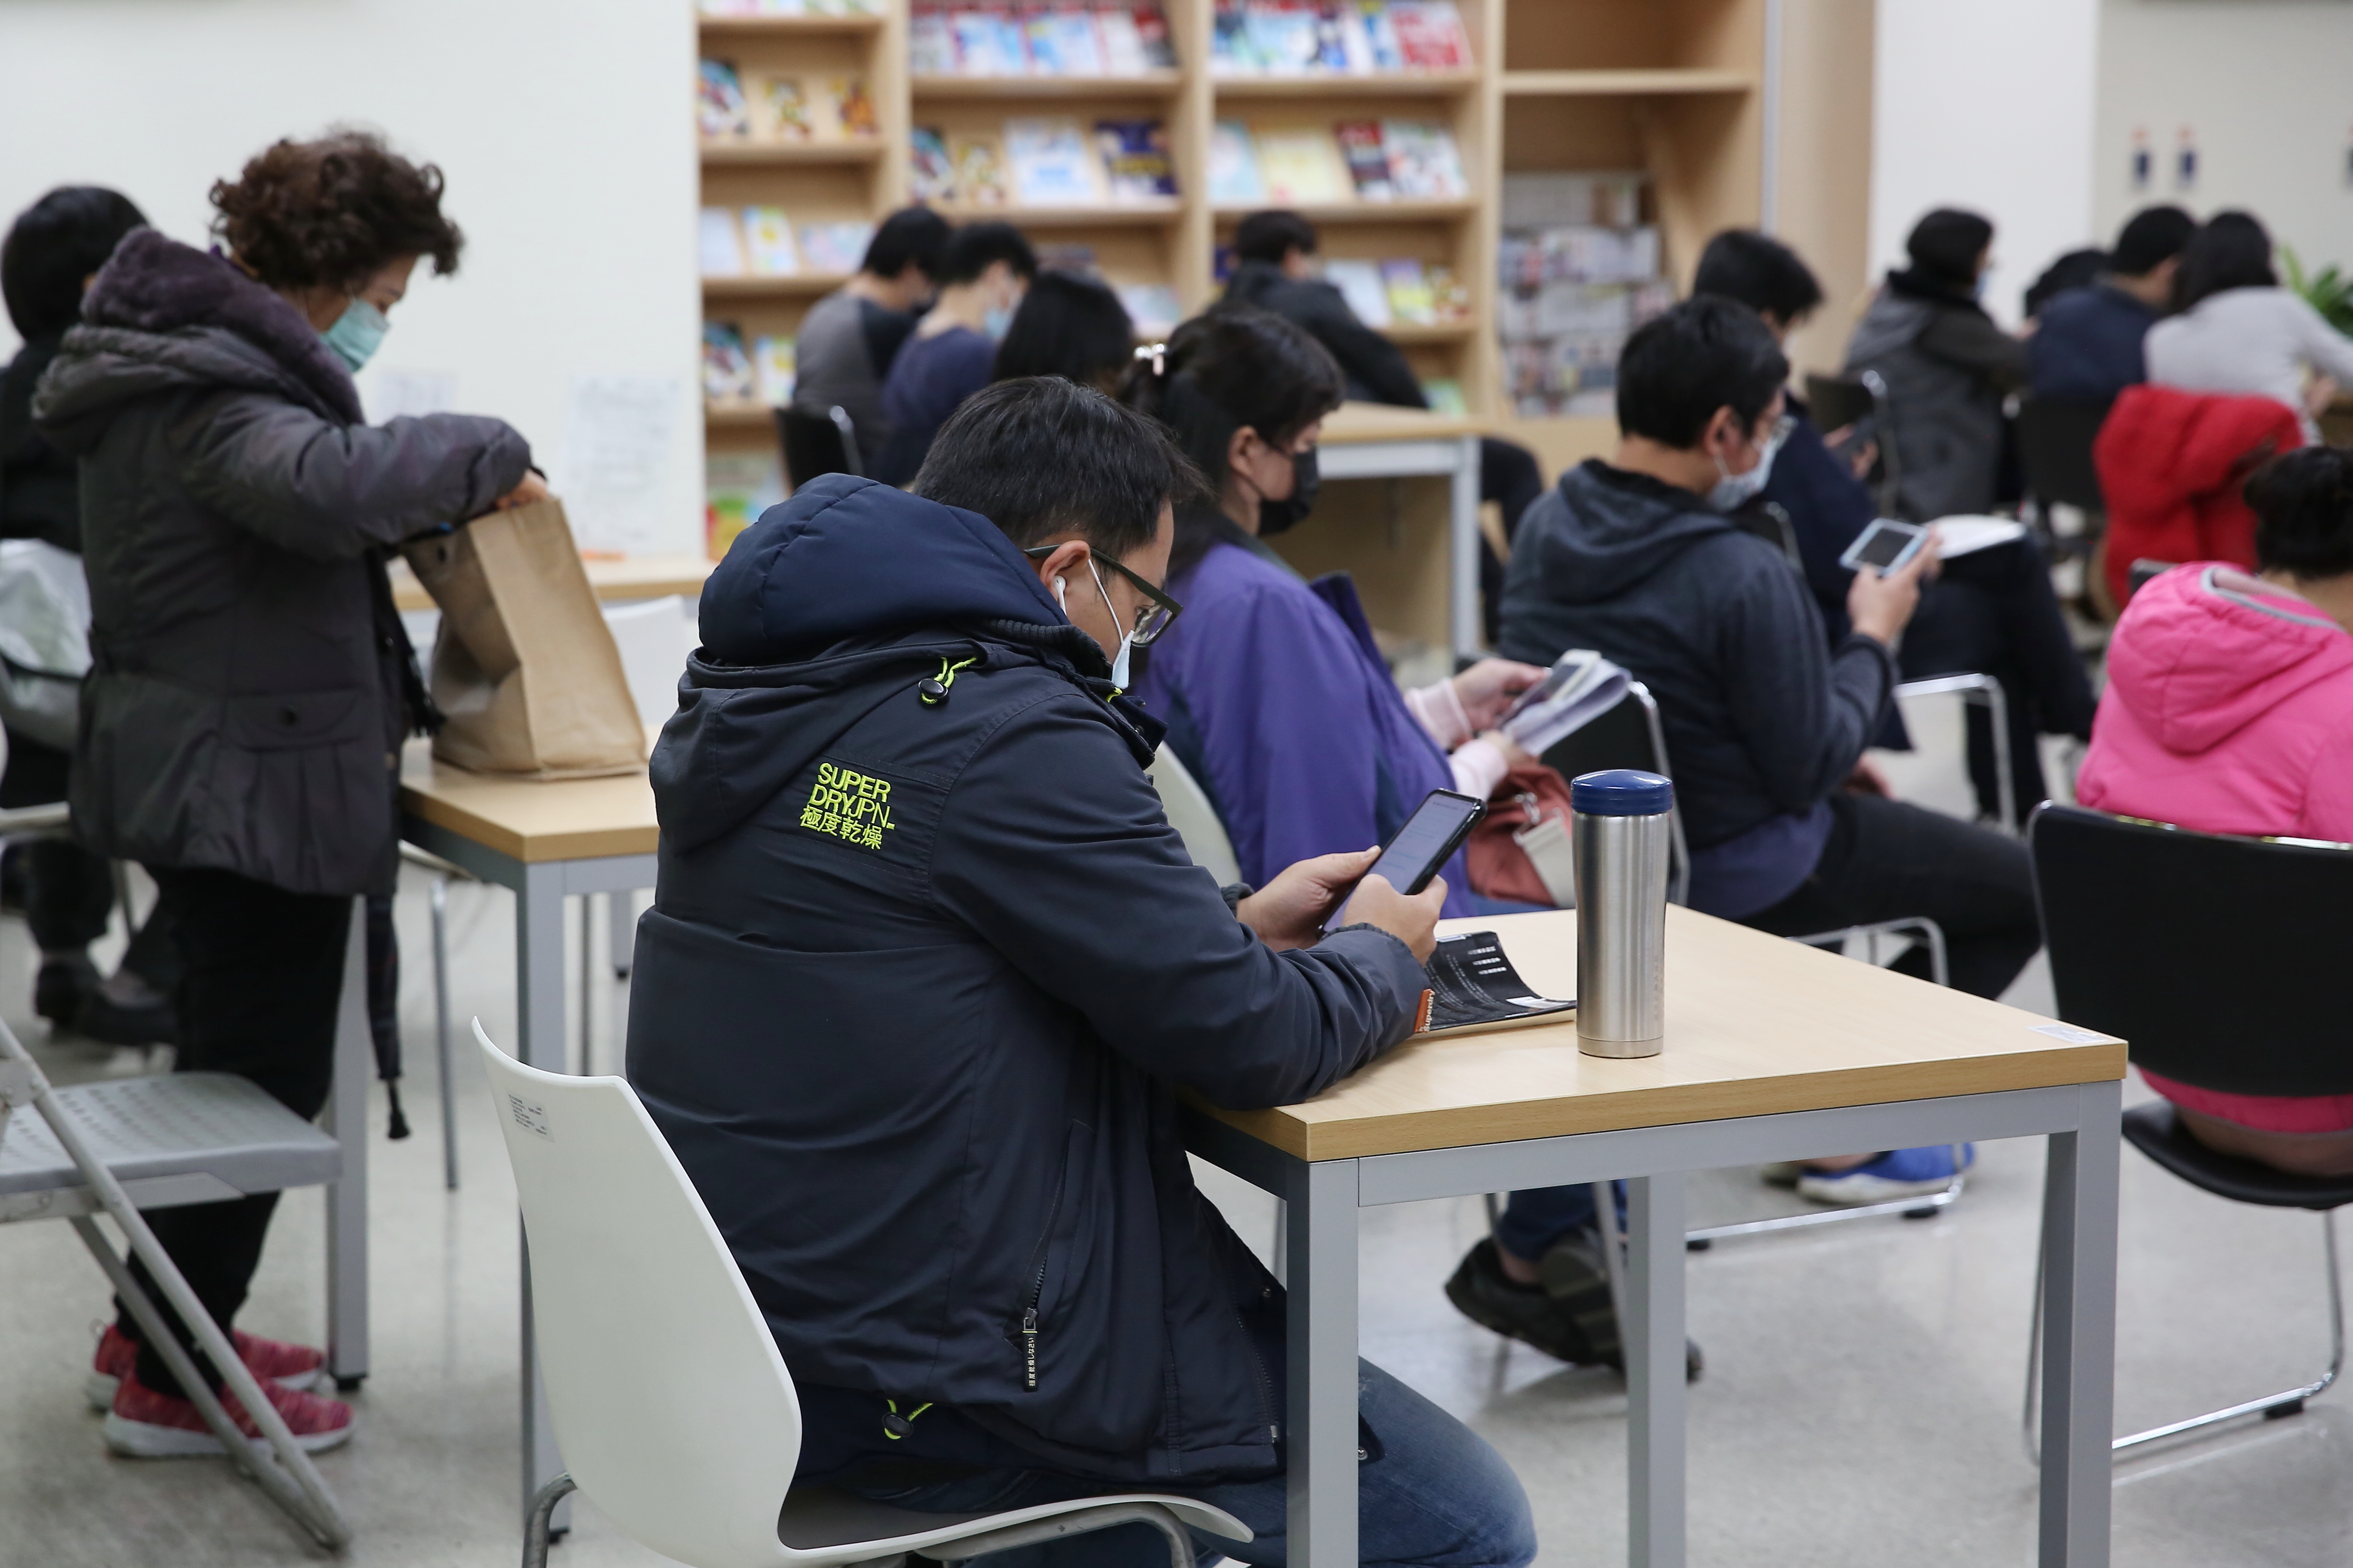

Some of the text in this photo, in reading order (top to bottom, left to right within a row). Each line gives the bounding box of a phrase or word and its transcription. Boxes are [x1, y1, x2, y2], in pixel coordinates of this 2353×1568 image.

[818, 763, 891, 802] SUPER
[800, 804, 883, 849] 極度乾燥
[1423, 989, 1435, 1032] Superdry
